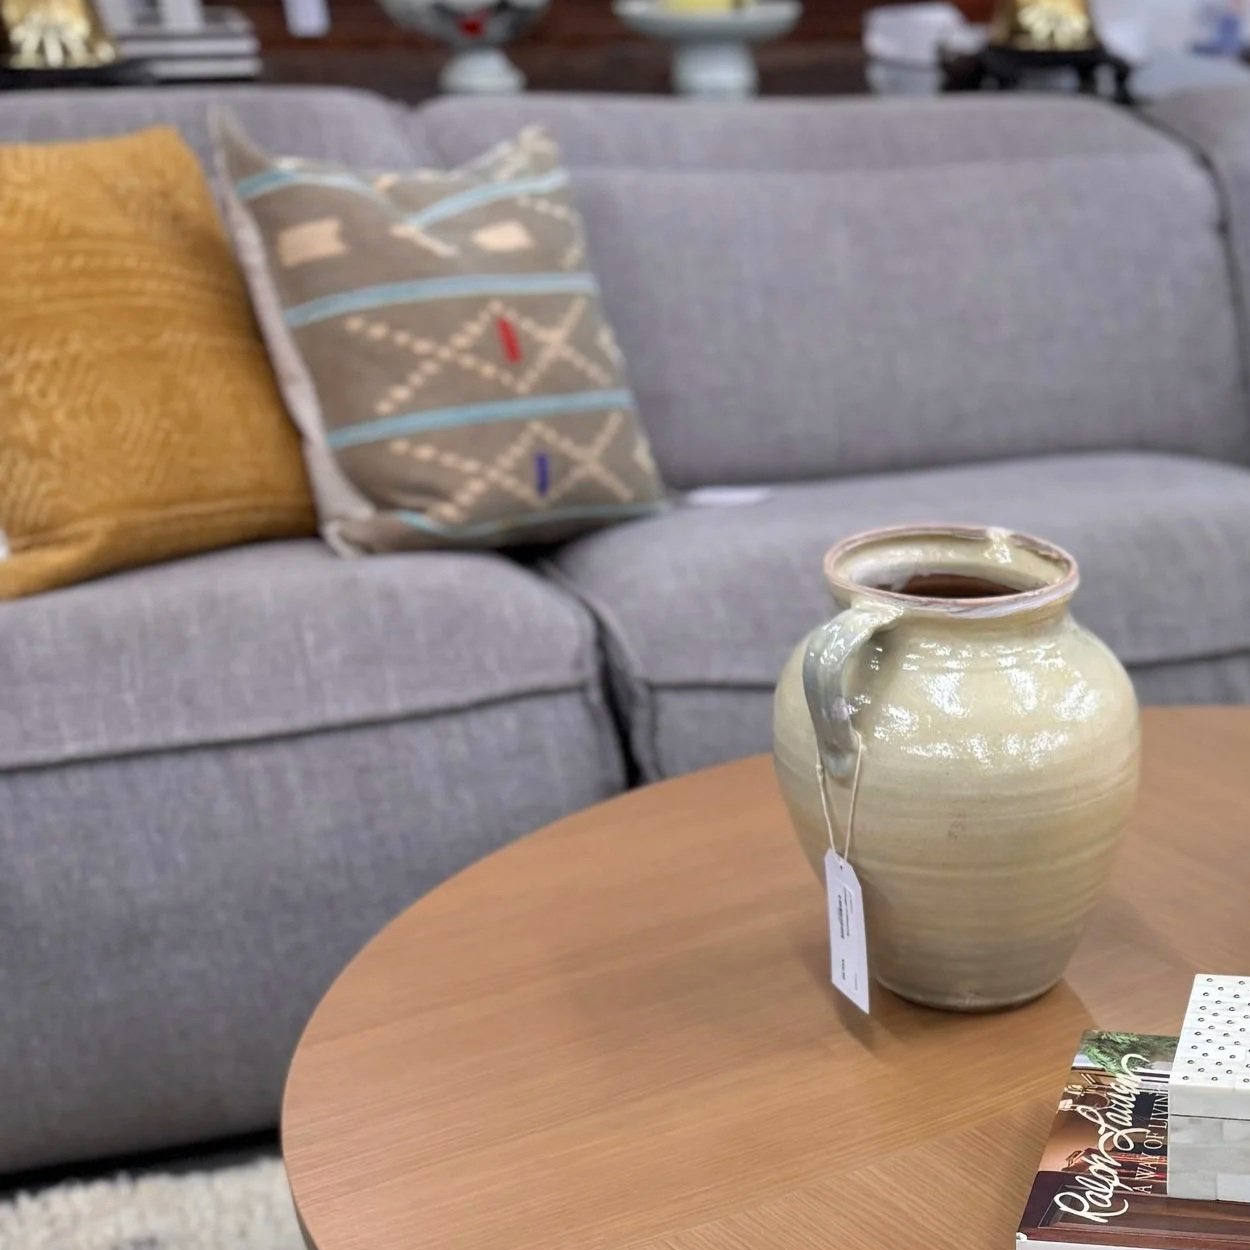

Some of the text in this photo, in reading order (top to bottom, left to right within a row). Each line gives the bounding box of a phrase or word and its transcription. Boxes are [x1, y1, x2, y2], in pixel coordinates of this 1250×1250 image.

[1053, 1053, 1150, 1223] Ralph Lauren
[1132, 1089, 1169, 1194] A WAY OF LIVIN
